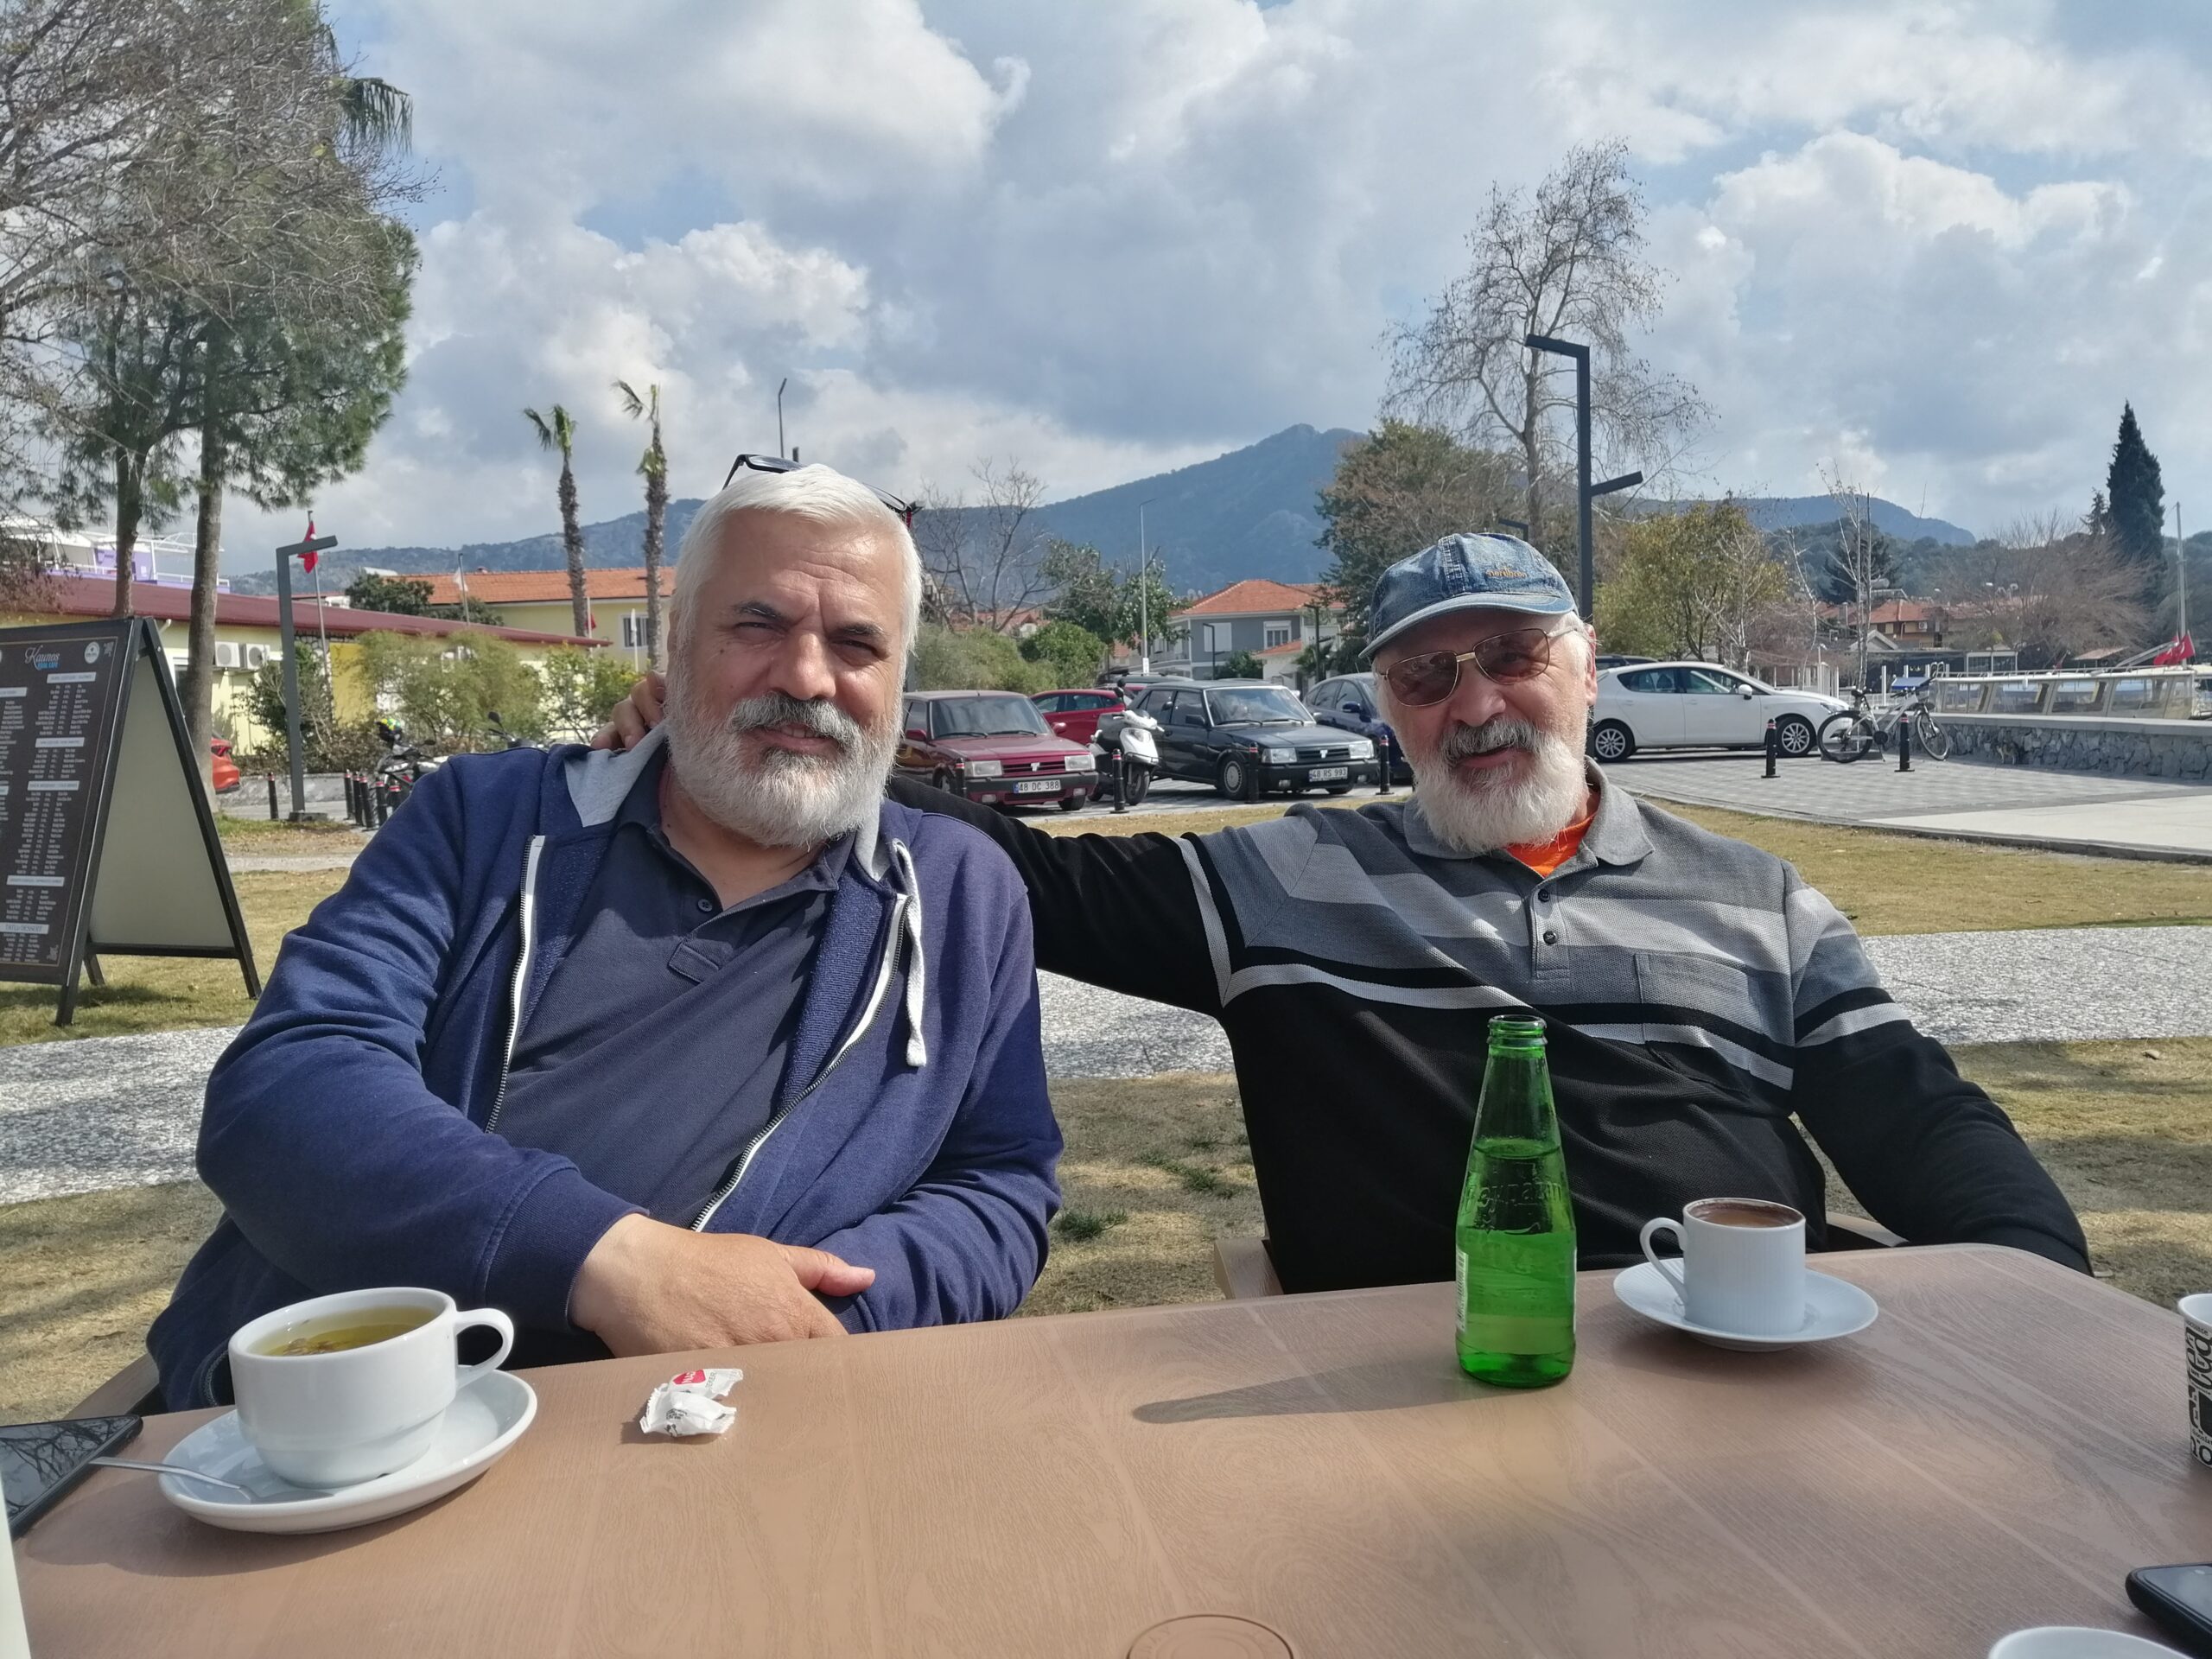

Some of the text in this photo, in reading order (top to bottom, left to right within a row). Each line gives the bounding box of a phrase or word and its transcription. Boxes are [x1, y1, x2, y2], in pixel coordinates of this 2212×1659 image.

[24, 645, 60, 671] Kaunos
[1032, 782, 1041, 791] DC
[1046, 781, 1059, 790] 388
